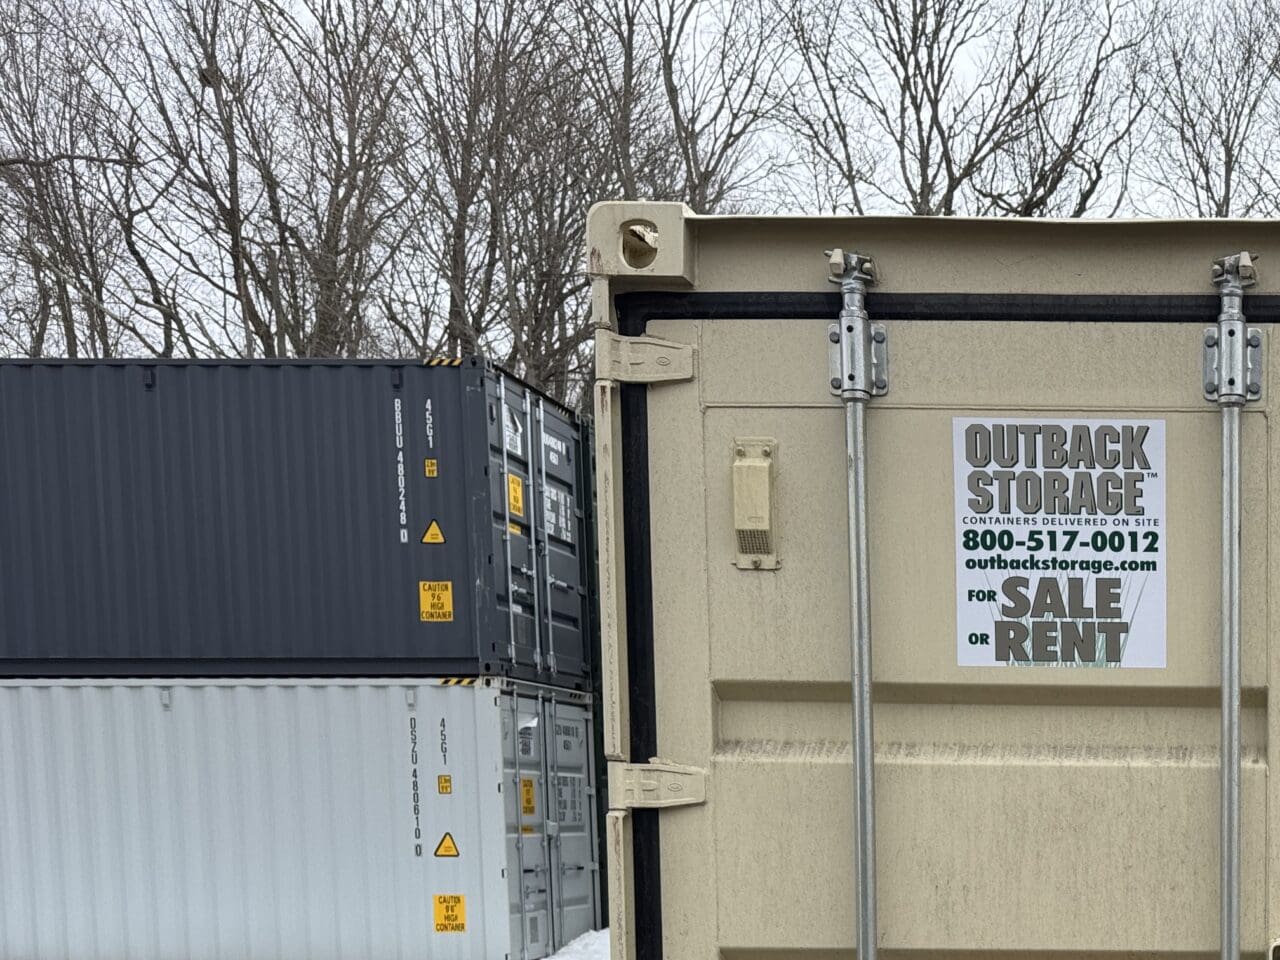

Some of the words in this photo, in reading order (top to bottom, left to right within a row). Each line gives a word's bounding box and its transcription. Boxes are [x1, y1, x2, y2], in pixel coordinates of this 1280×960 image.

[394, 398, 404, 449] BBUU
[425, 398, 434, 449] 45G1
[965, 423, 1151, 470] OUTBACK
[397, 451, 407, 525] 480248
[967, 470, 1145, 516] STORAGE
[962, 516, 1038, 526] CONTAINERS
[1042, 517, 1108, 527] DELIVERED
[1112, 518, 1130, 527] ON
[1134, 518, 1161, 527] SITE
[962, 529, 1160, 553] 800-517-0012
[965, 554, 1158, 574] outbackstorage.com
[422, 583, 449, 592] CAUTION
[967, 589, 998, 602] FOR
[1001, 576, 1122, 619] SALE
[968, 632, 990, 646] OR
[995, 621, 1129, 662] RENT
[440, 717, 448, 766] 45G1
[412, 768, 421, 840] 480610
[438, 895, 462, 904] CAUTION
